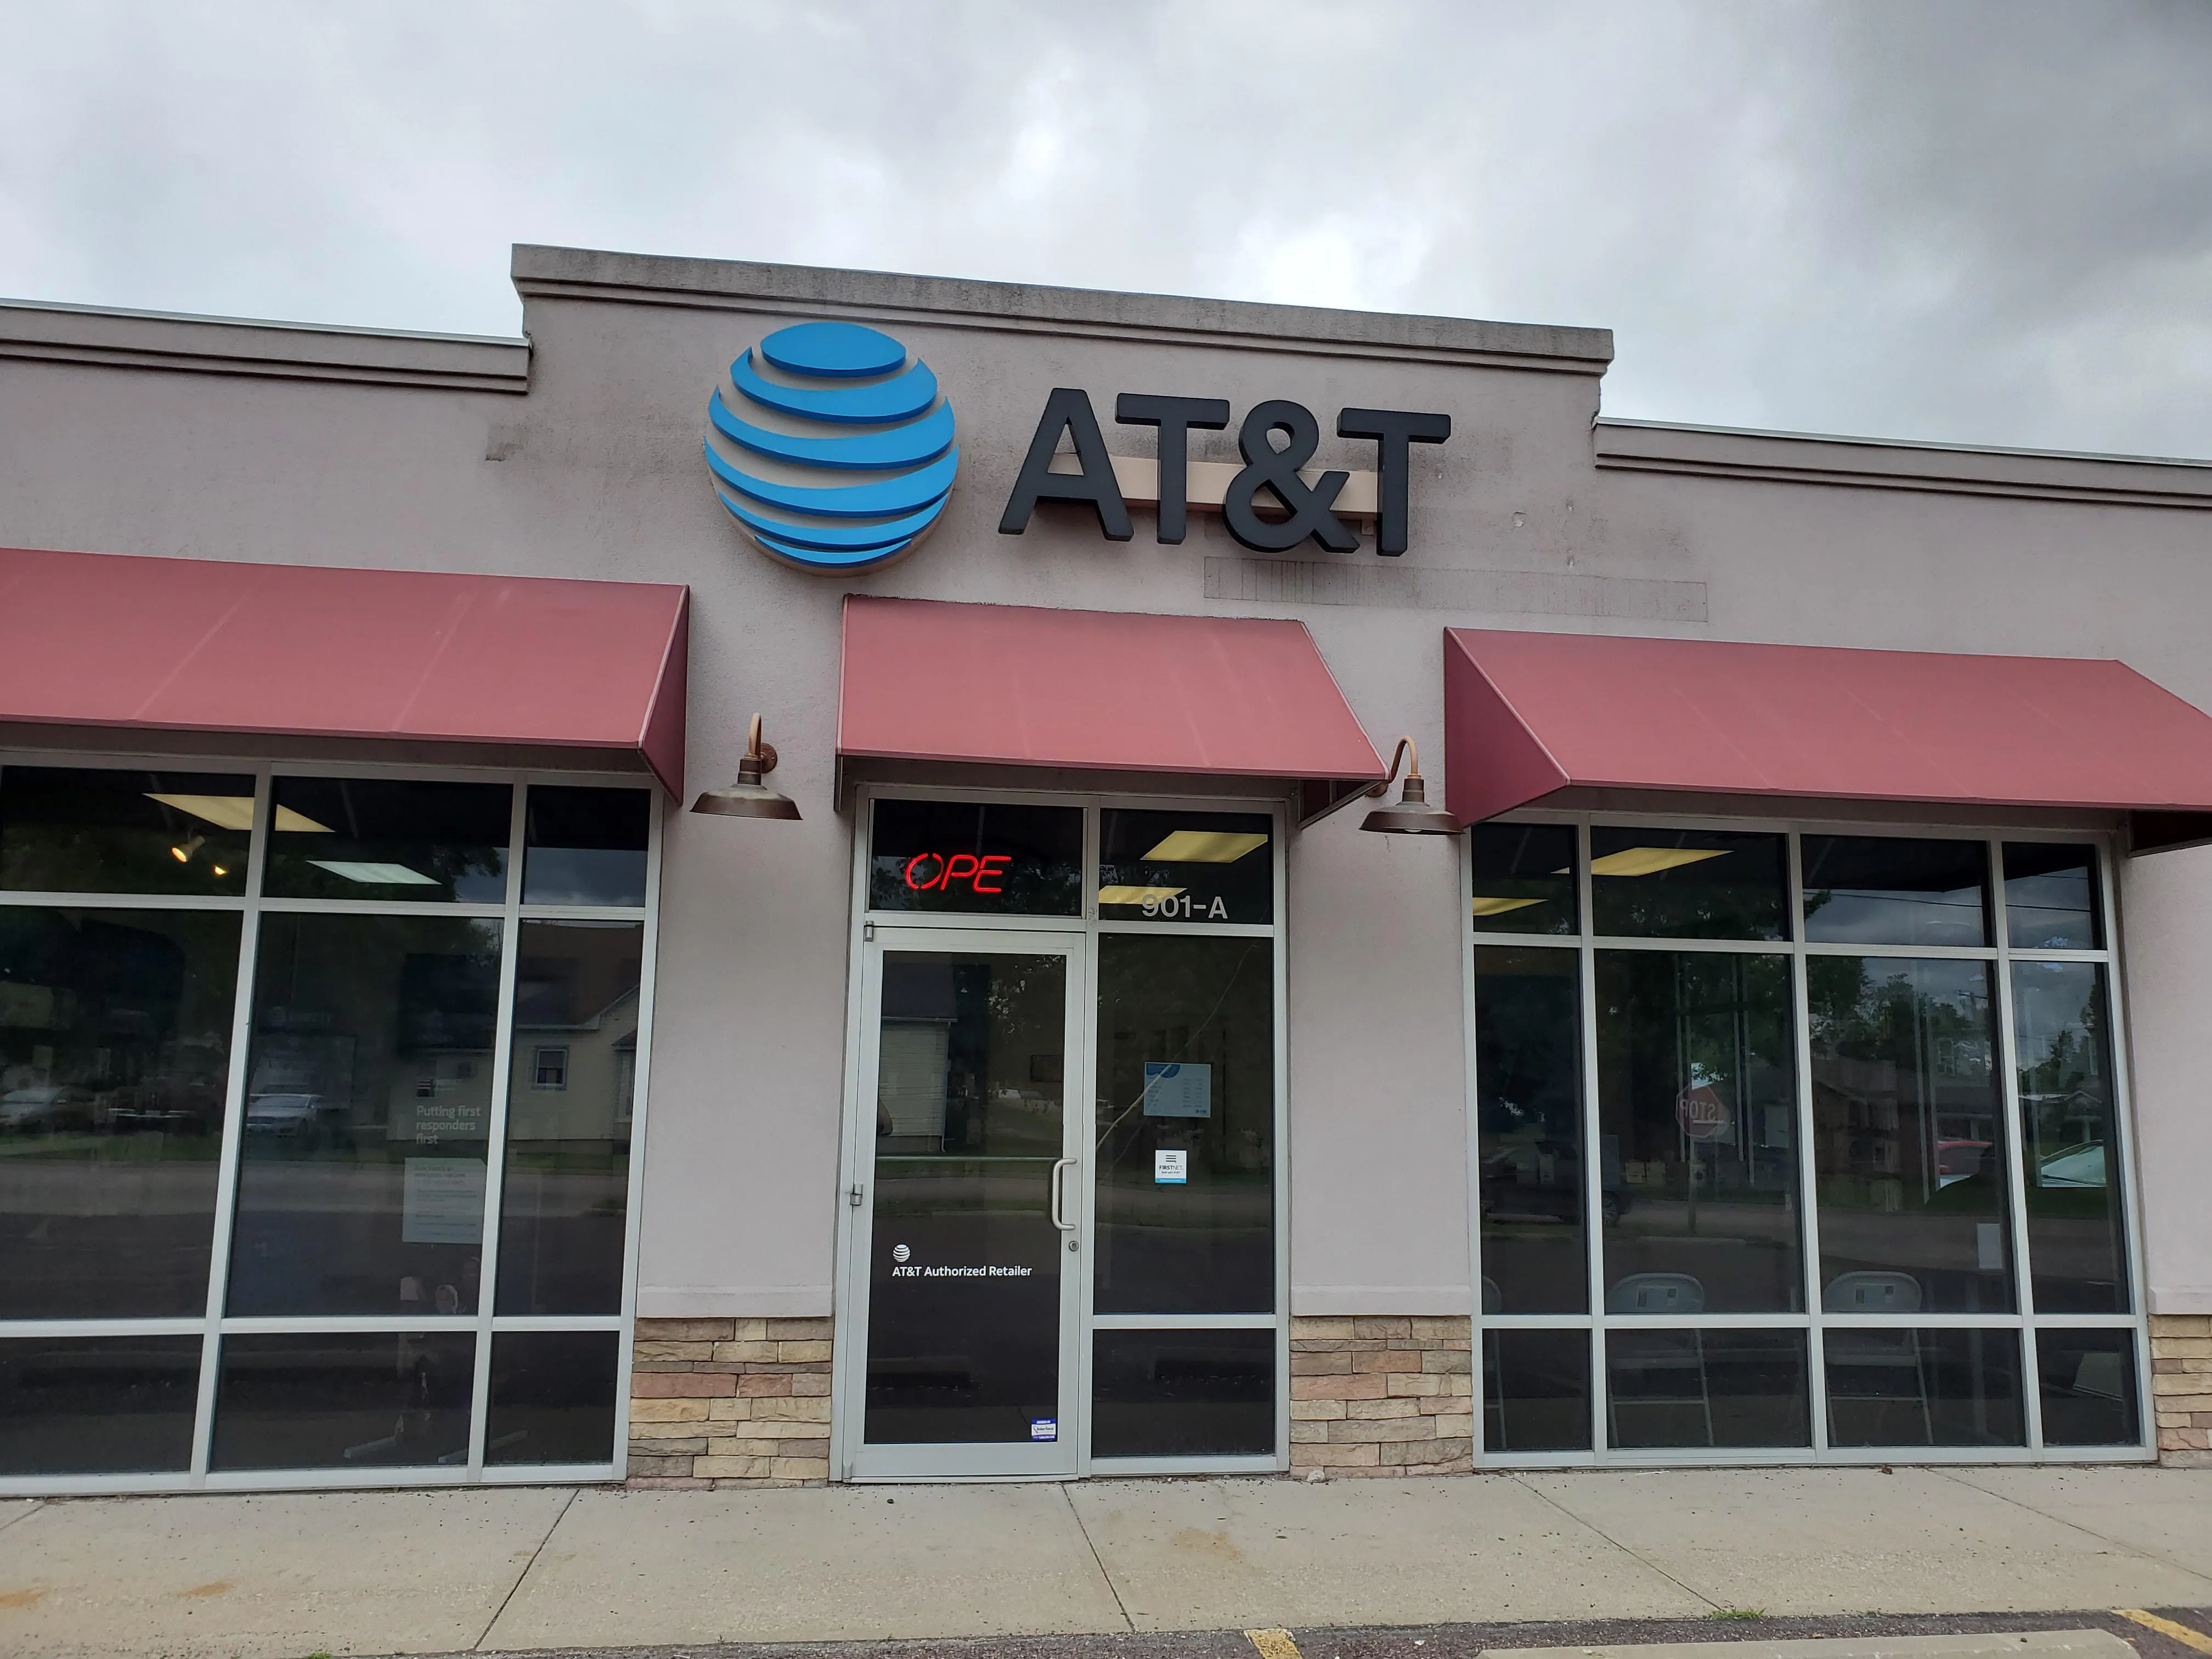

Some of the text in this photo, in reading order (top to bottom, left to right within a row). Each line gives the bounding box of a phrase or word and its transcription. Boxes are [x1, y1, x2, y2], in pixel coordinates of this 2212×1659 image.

[998, 387, 1452, 557] AT&T
[1141, 894, 1228, 919] 901-A
[416, 1105, 482, 1119] Putting first
[416, 1120, 476, 1134] responders
[416, 1133, 439, 1145] first
[892, 1266, 1032, 1277] AT&T Authorized Retailer
